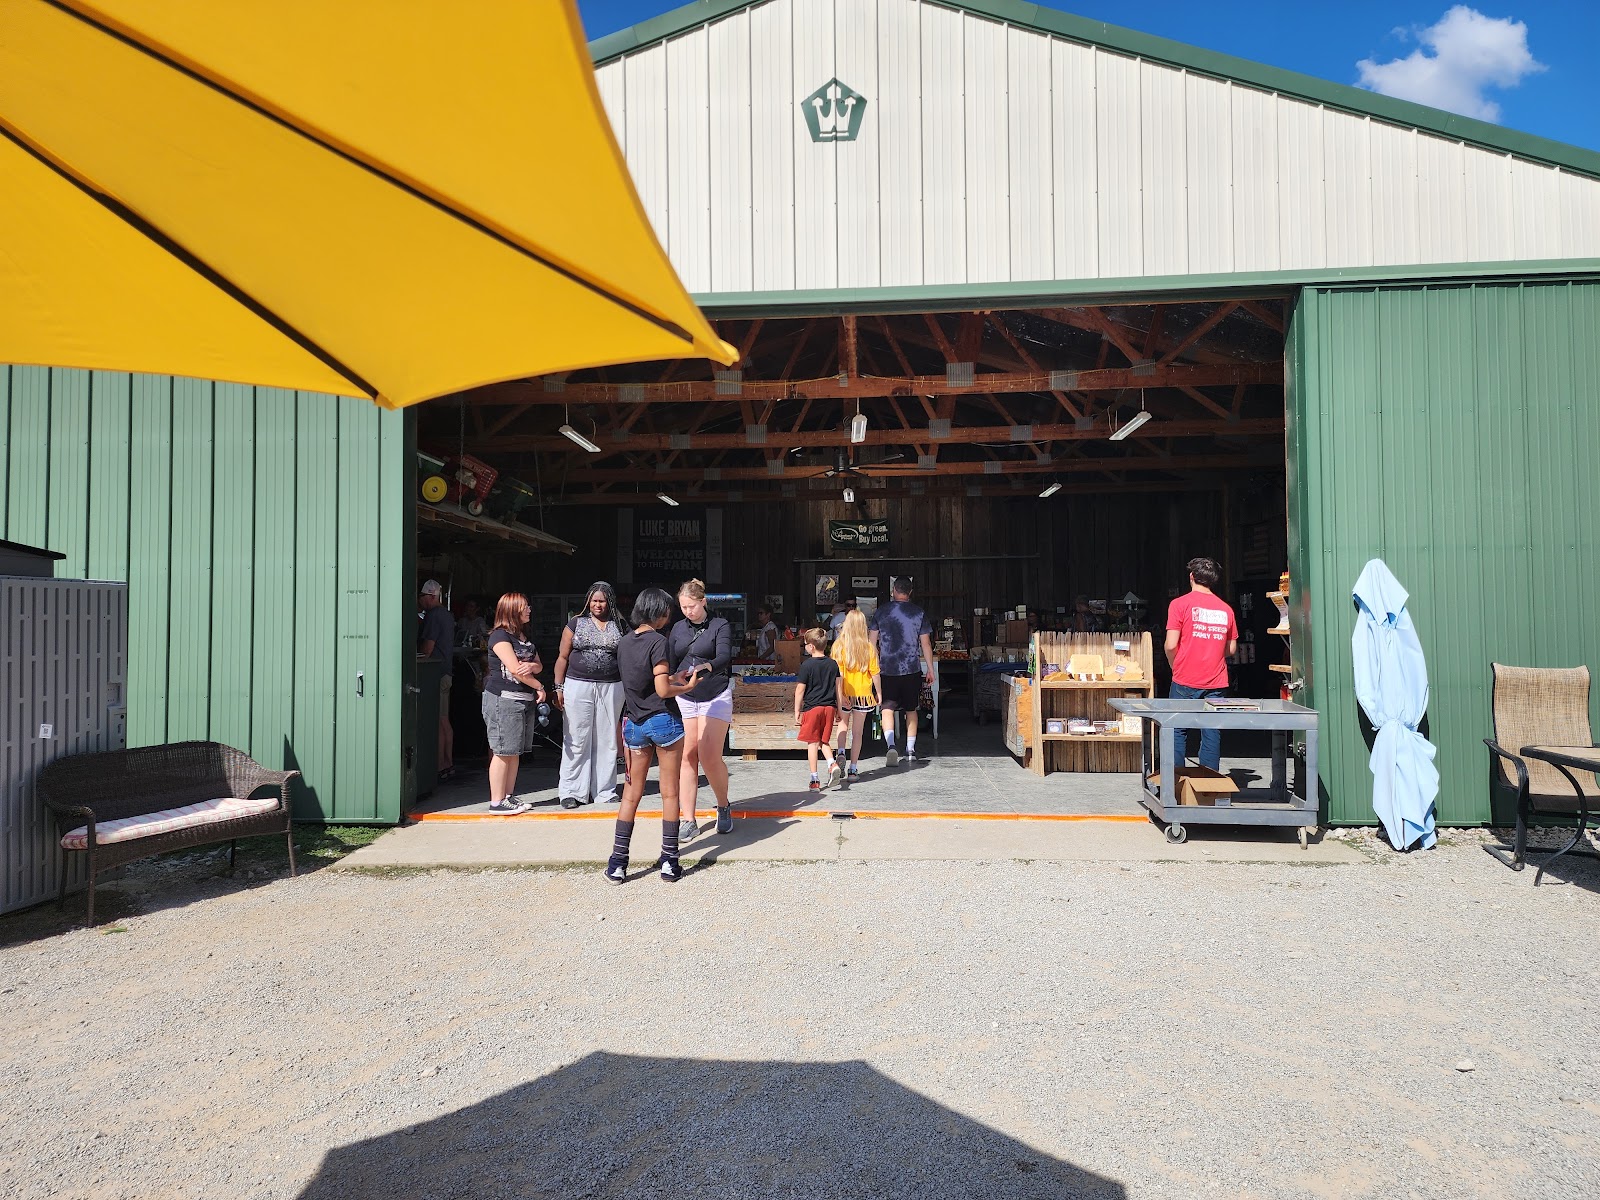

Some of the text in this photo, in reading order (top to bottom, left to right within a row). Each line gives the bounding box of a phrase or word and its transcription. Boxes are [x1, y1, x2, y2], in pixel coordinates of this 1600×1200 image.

[640, 520, 700, 536] LUKE BRYAN
[858, 525, 867, 533] Go
[858, 534, 870, 545] Buy
[636, 549, 703, 560] WELCOME
[664, 560, 703, 570] FARM
